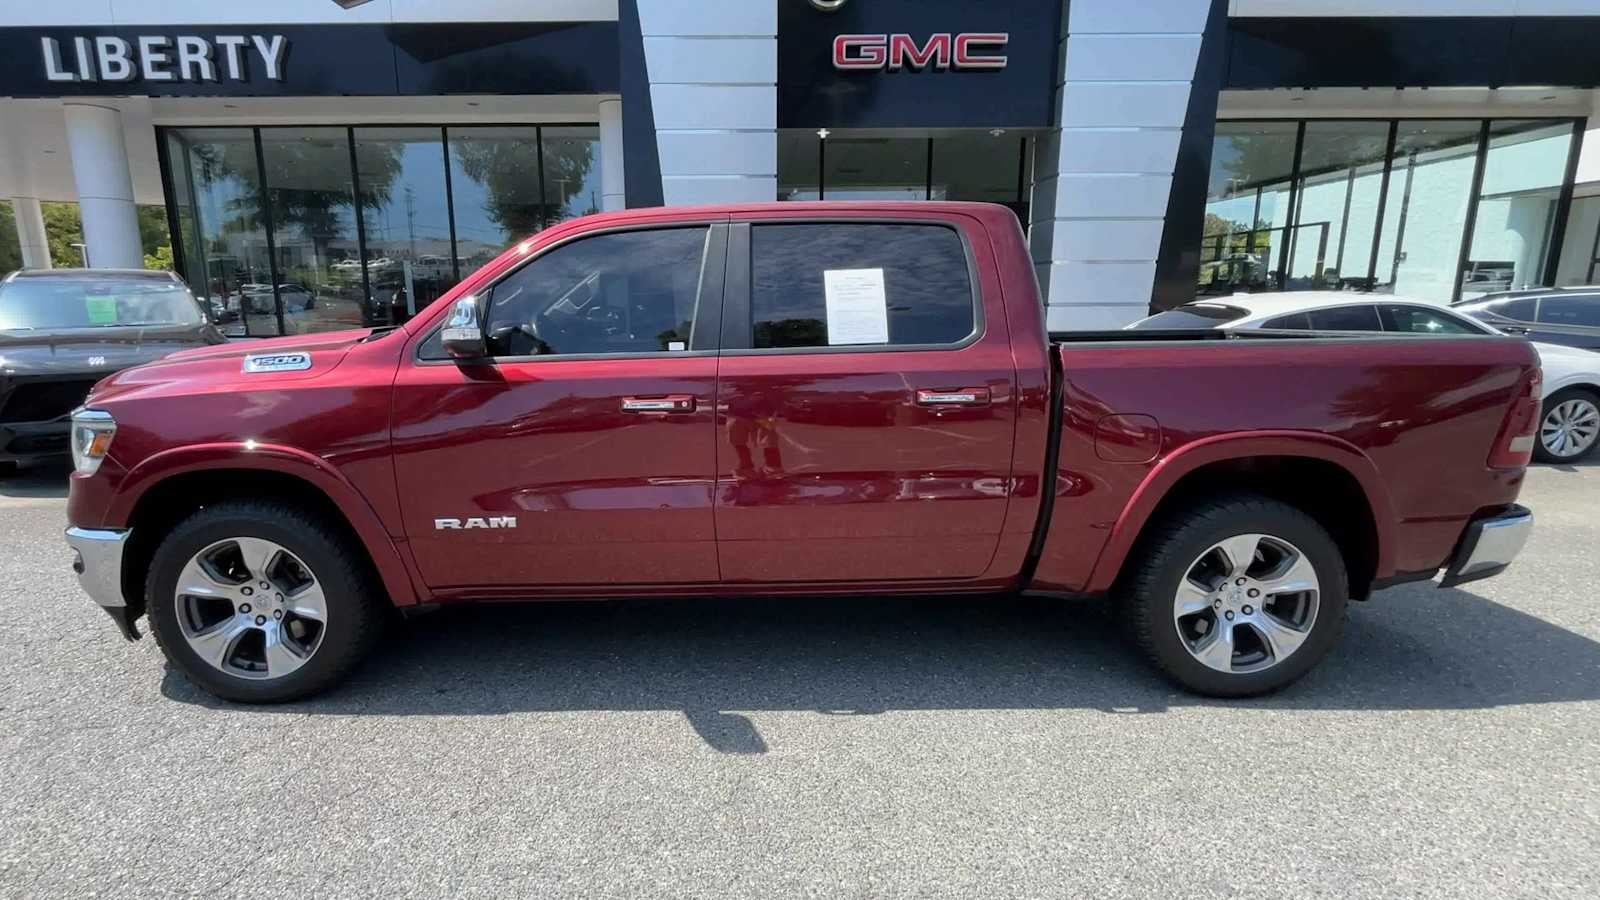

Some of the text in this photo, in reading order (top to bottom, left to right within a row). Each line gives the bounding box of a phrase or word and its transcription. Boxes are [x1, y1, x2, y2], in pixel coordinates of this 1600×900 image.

[41, 35, 284, 81] LIBERTY
[833, 33, 1008, 69] GMC
[253, 355, 305, 366] 1500
[435, 517, 517, 530] RAM
